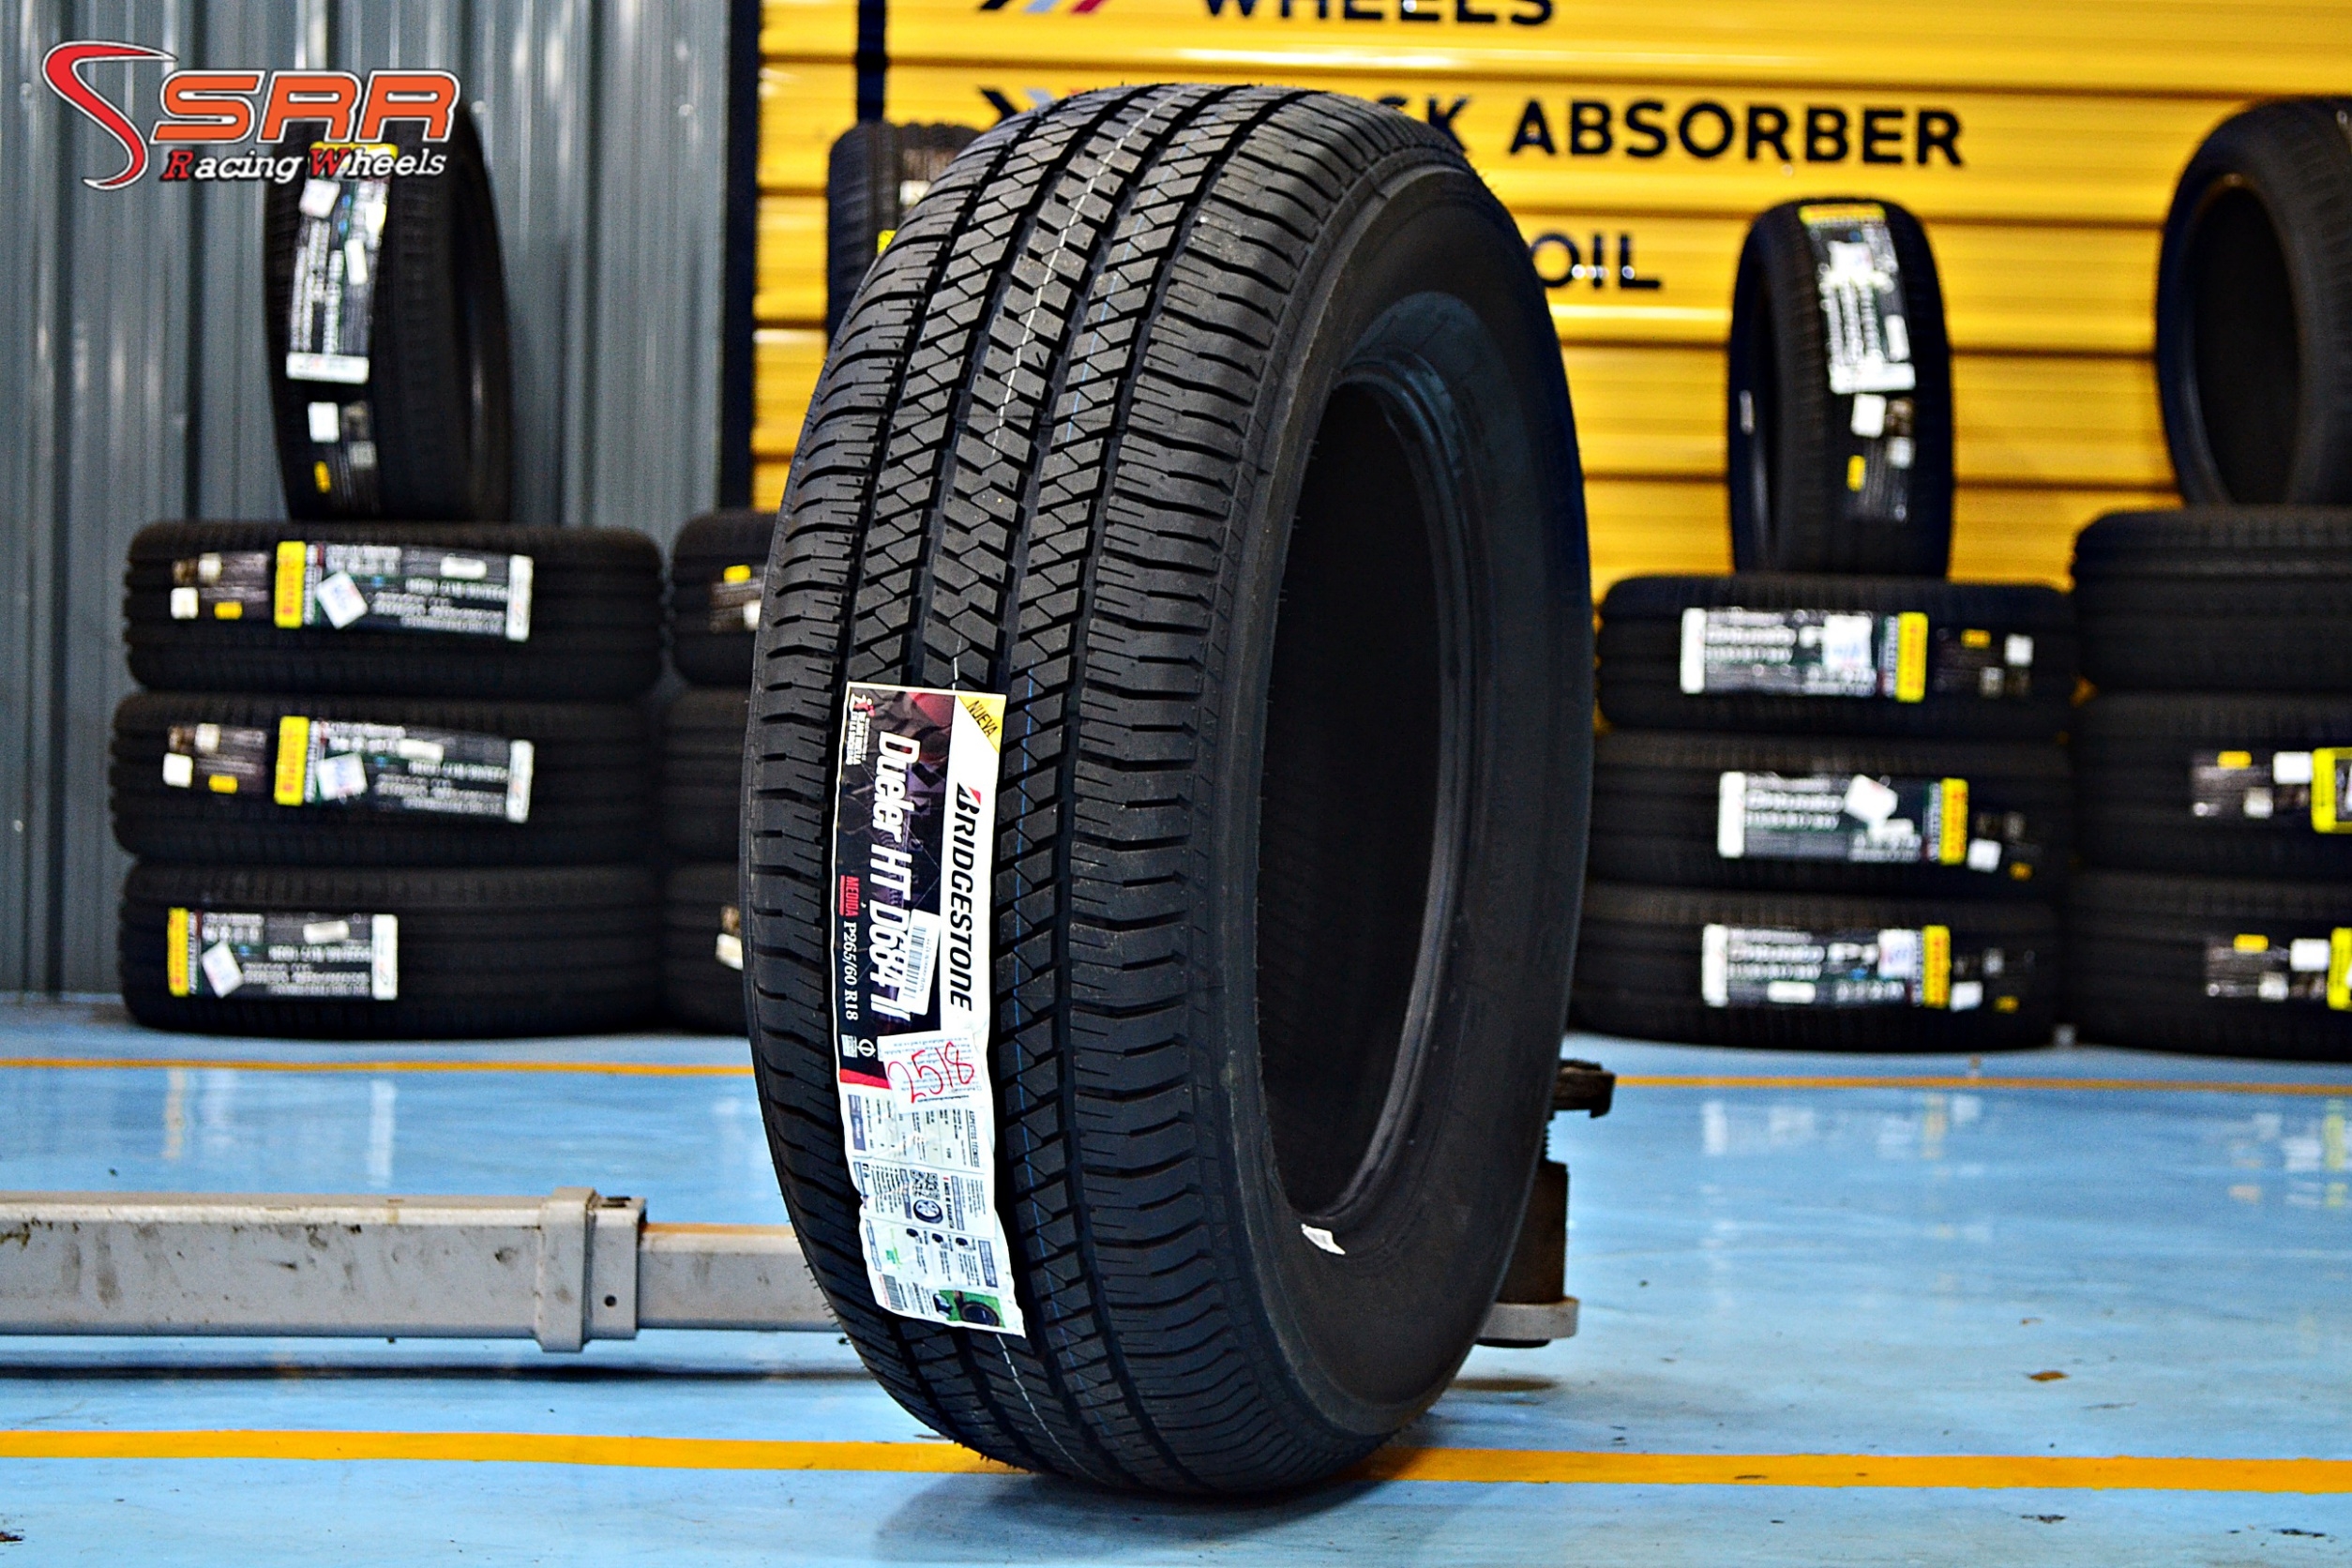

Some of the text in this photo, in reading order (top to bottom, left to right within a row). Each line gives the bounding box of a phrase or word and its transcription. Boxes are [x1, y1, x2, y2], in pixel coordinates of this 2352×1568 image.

[1509, 99, 1965, 166] ABSORBER
[1530, 233, 1661, 290] OIL
[966, 701, 998, 738] NUEVA
[872, 731, 921, 843] Dueler
[869, 844, 912, 900] HT
[950, 783, 981, 1011] BRIDGESTONE
[842, 921, 857, 985] P265/60
[869, 899, 910, 988] D684
[844, 988, 858, 1020] R18
[886, 1040, 975, 1104] 2518
